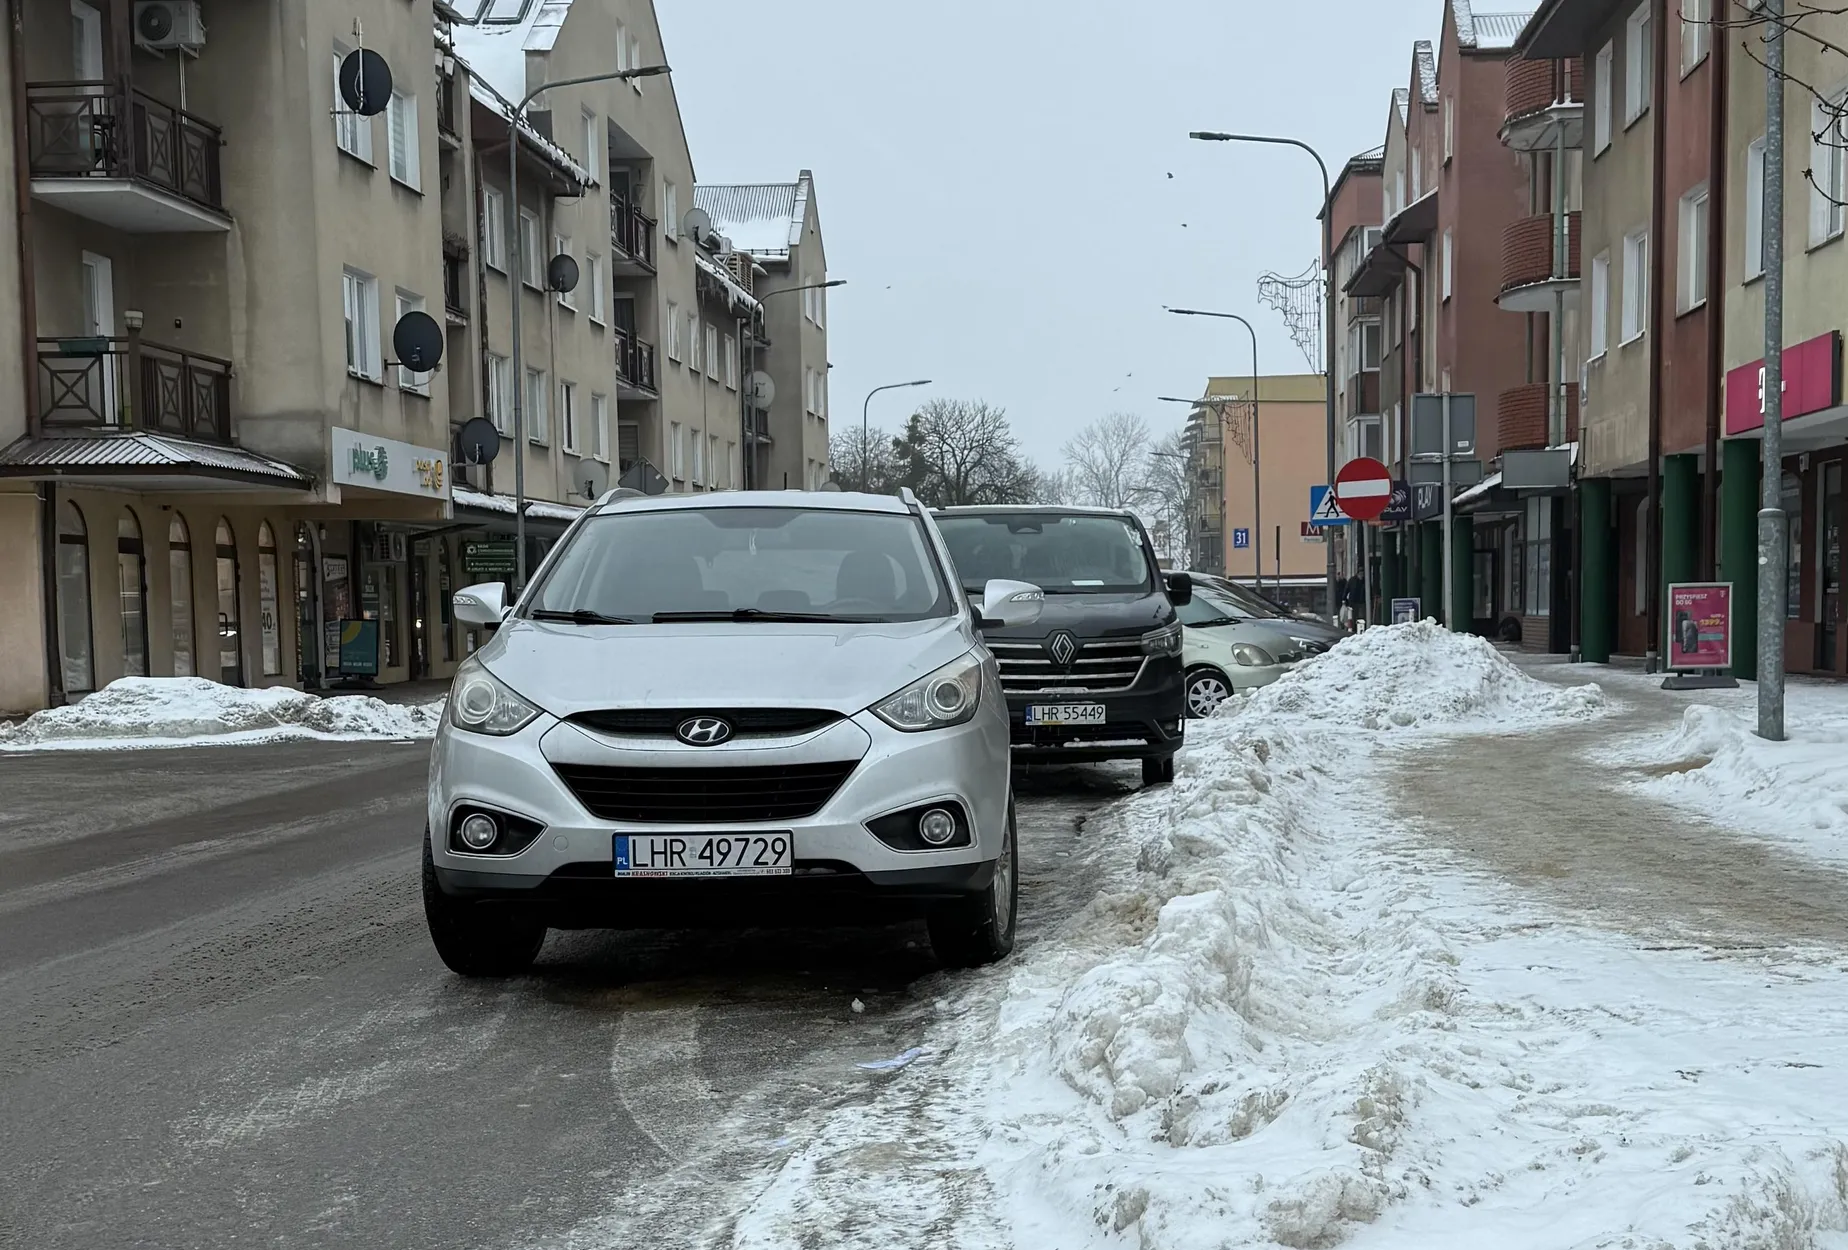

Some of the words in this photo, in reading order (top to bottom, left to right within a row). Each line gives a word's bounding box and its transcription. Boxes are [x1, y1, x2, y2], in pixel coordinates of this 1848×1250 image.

[1236, 532, 1246, 544] 31
[1033, 707, 1059, 721] LHR
[1063, 706, 1104, 720] 55449
[632, 838, 687, 868] LHR
[698, 837, 787, 867] 49729
[617, 857, 628, 865] PL
